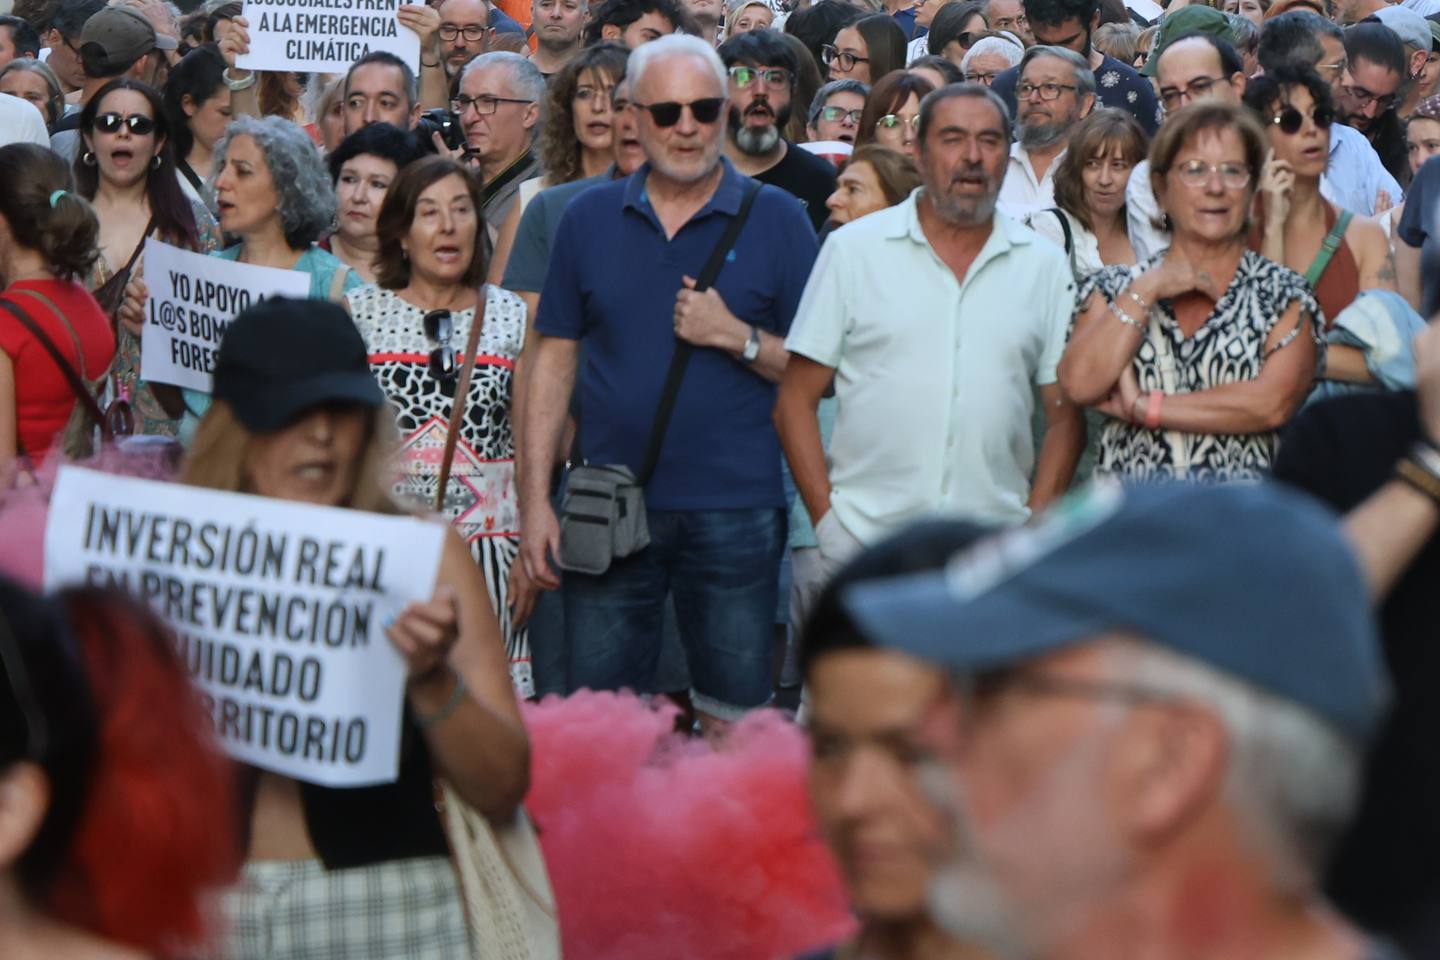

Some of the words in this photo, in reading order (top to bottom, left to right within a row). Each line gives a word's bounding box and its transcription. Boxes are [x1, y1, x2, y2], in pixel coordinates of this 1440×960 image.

[259, 12, 270, 31] A
[273, 12, 292, 33] LA
[296, 13, 397, 37] EMERGENCIA
[170, 270, 190, 302] YO
[194, 279, 250, 315] APOYO
[150, 298, 187, 334] L@S
[84, 503, 287, 581] INVERSIÓN
[295, 537, 385, 594] REAL
